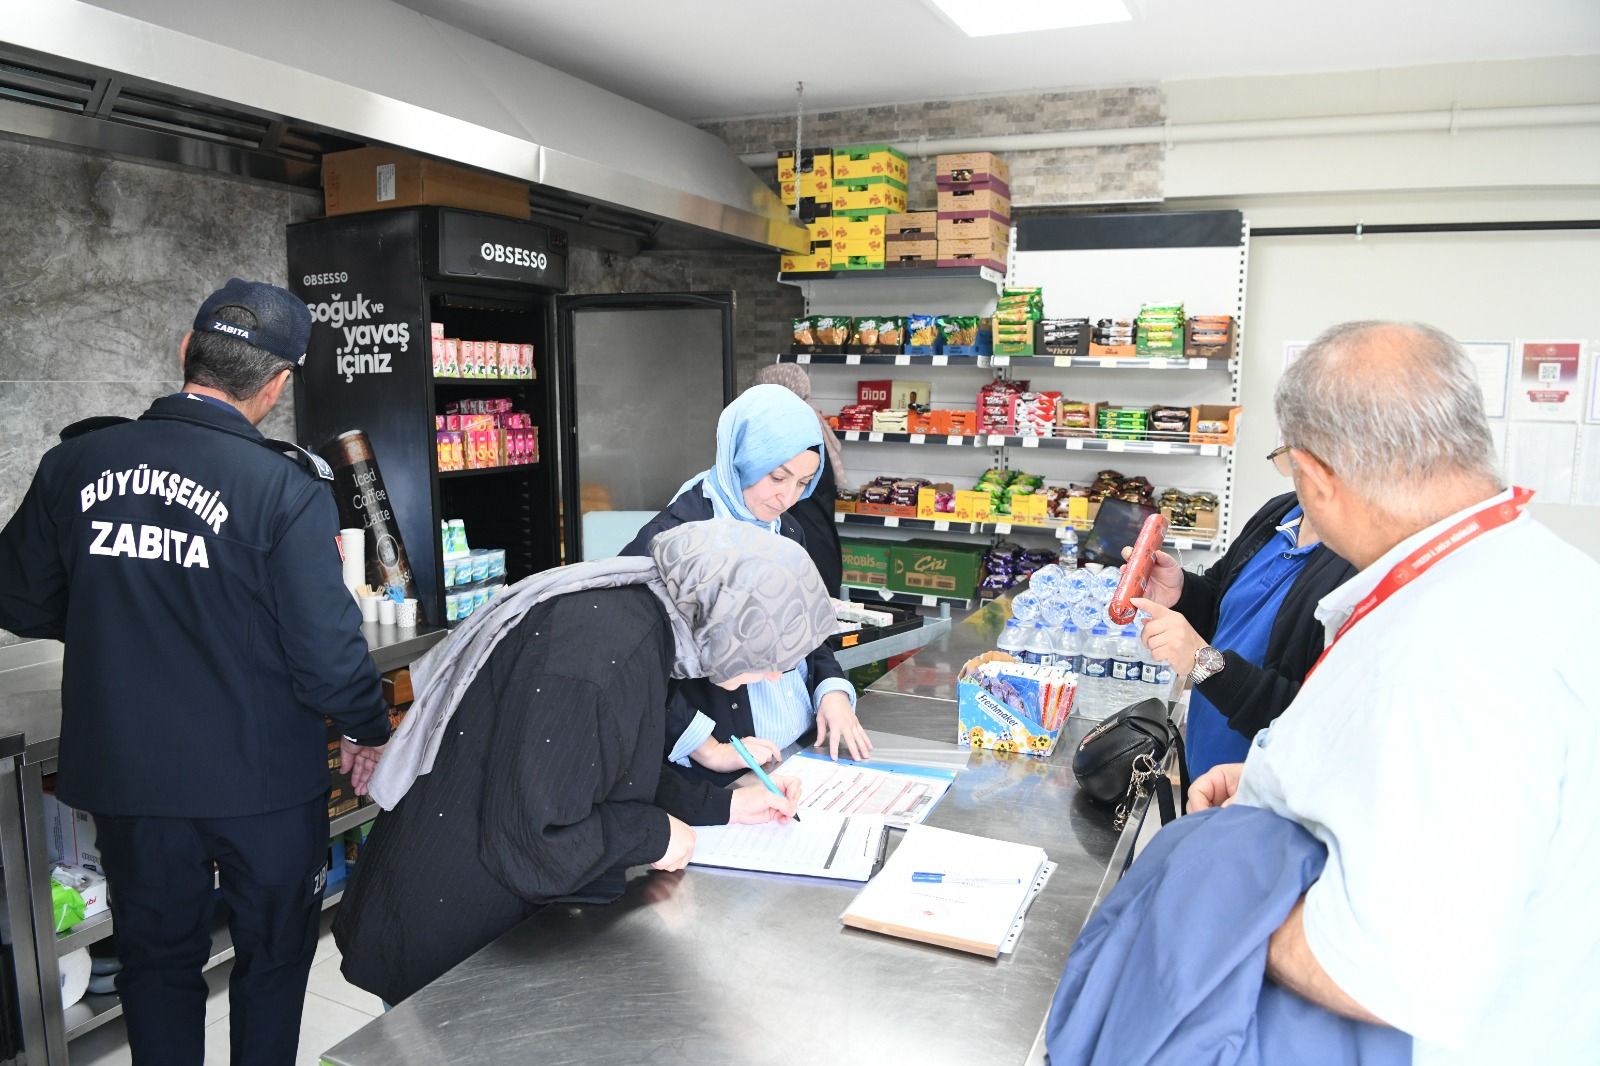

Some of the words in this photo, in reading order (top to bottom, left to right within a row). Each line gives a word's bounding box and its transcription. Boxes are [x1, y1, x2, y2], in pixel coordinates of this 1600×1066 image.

[481, 242, 547, 270] OBSESSO
[303, 271, 348, 286] OBSESSO
[306, 293, 371, 328] soğuk
[371, 302, 384, 313] ve
[213, 321, 249, 339] ZABITA
[343, 322, 410, 352] yavaş
[336, 345, 392, 383] içiniz
[352, 467, 377, 488] Iced
[80, 463, 230, 535] BÜYÜKŞEHİR
[352, 488, 387, 509] Coffee
[362, 509, 391, 528] Latte
[89, 520, 210, 569] ZABITA
[977, 694, 1019, 727] Freshmaker
